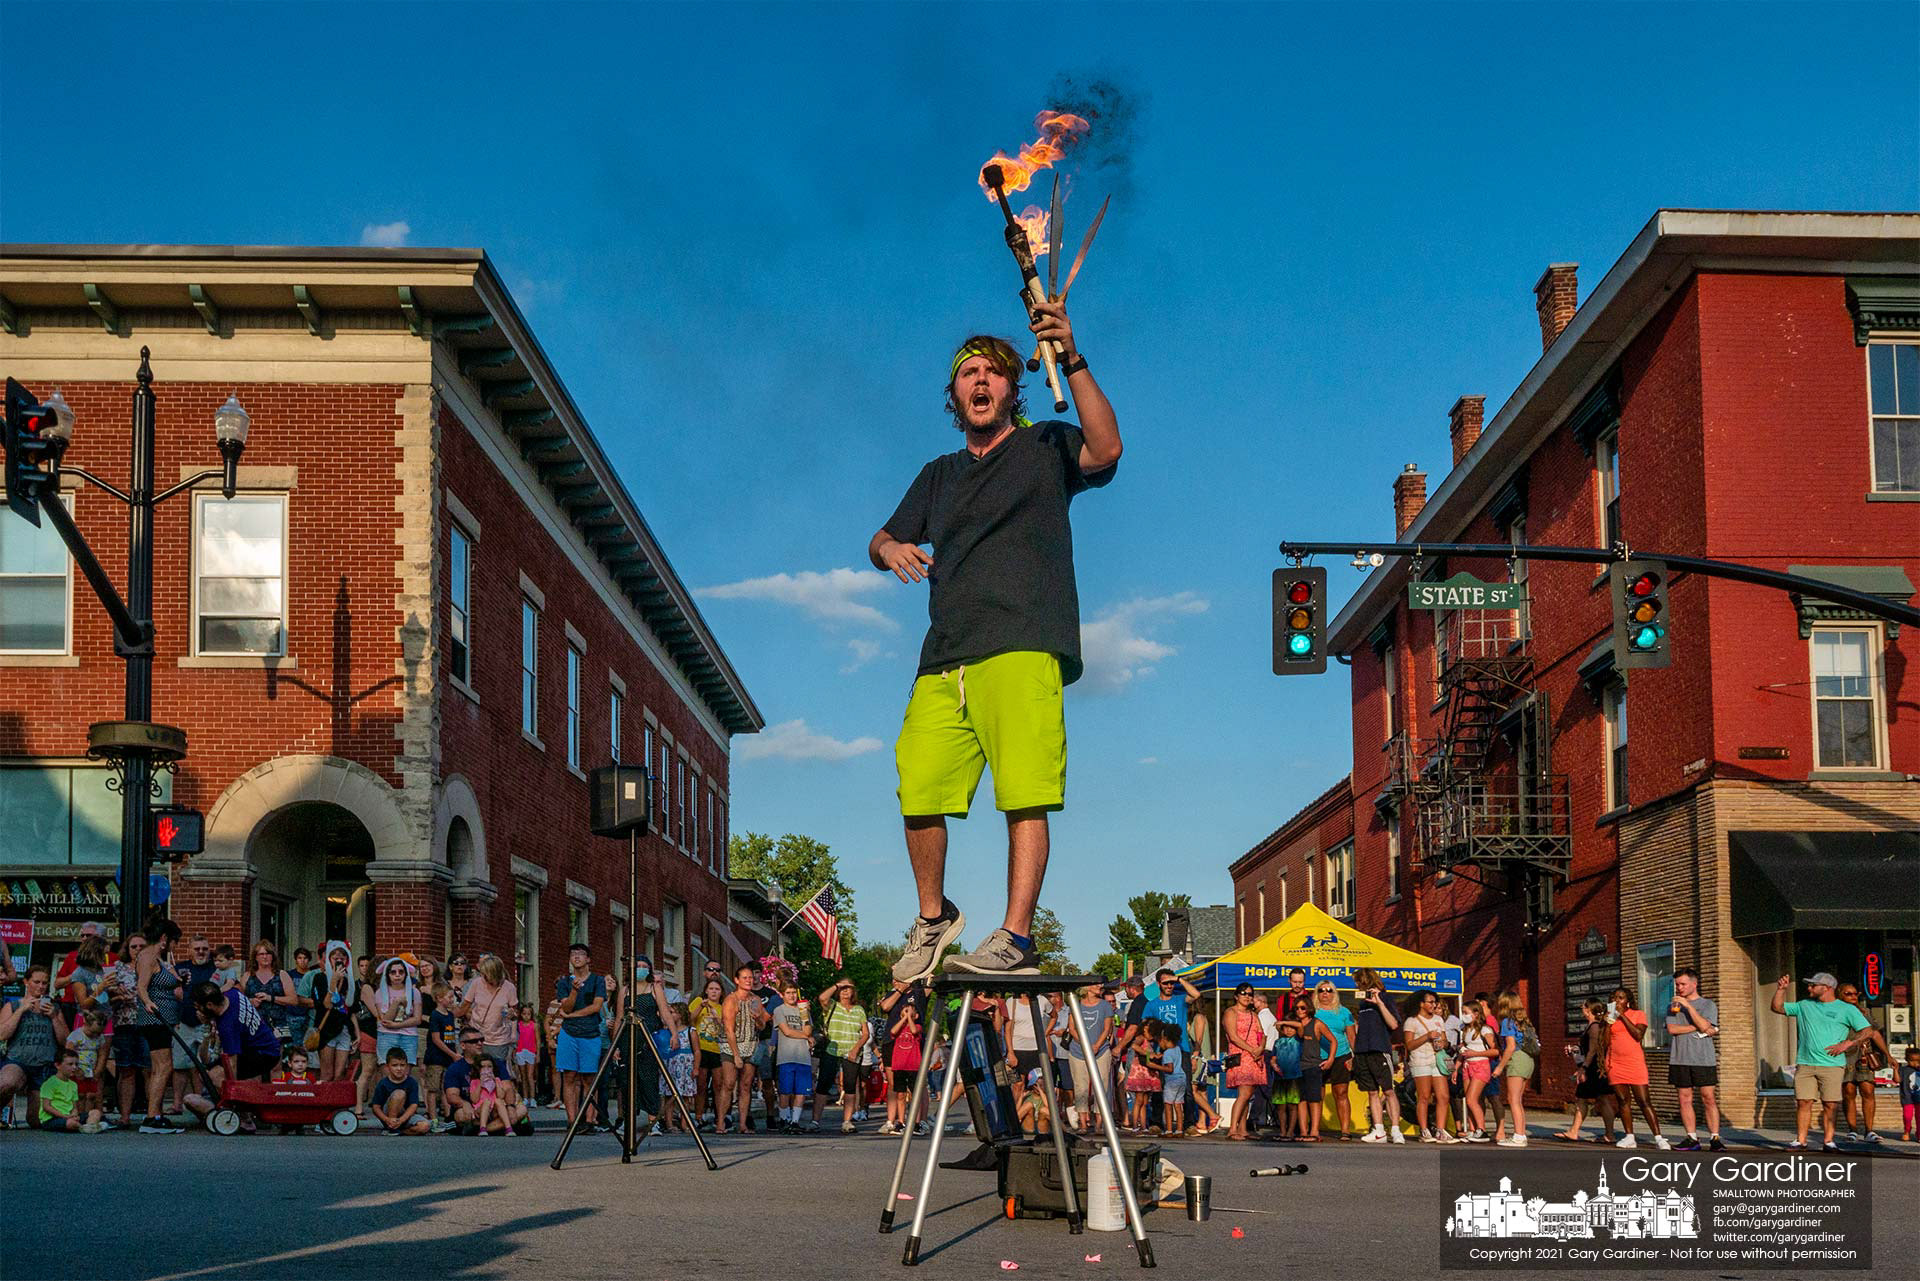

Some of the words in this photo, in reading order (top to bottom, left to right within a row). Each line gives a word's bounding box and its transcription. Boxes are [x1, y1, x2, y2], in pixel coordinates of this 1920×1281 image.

[1421, 587, 1486, 605] STATE
[1490, 590, 1508, 603] ST
[48, 906, 75, 914] STATE
[76, 906, 108, 914] STREET
[1245, 966, 1277, 978] Help
[1400, 970, 1437, 981] Word
[1866, 953, 1879, 995] OPEN
[1408, 980, 1437, 989] cci.org
